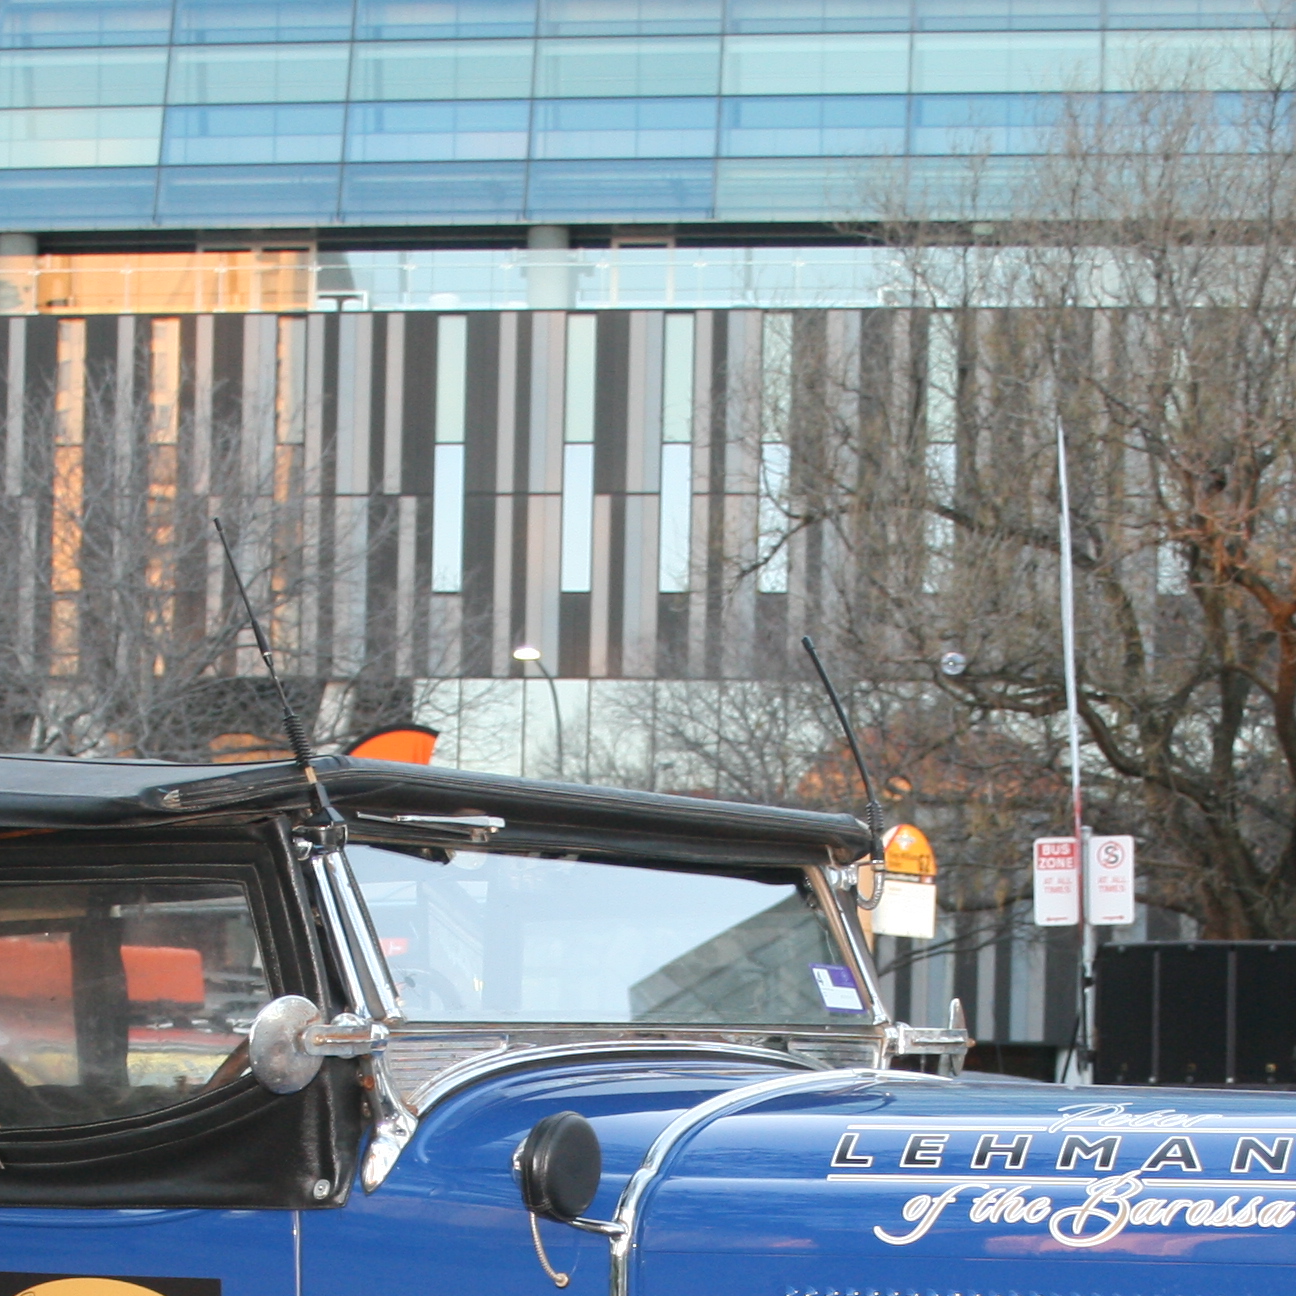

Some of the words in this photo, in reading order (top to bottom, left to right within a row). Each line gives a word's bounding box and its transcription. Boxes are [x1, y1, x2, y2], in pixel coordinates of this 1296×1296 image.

[1041, 843, 1072, 856] BUS
[1038, 857, 1075, 869] ZONE
[1048, 1101, 1223, 1133] Peter
[873, 1183, 991, 1245] of
[968, 1184, 1051, 1225] the
[1048, 1170, 1296, 1248] Barossa
